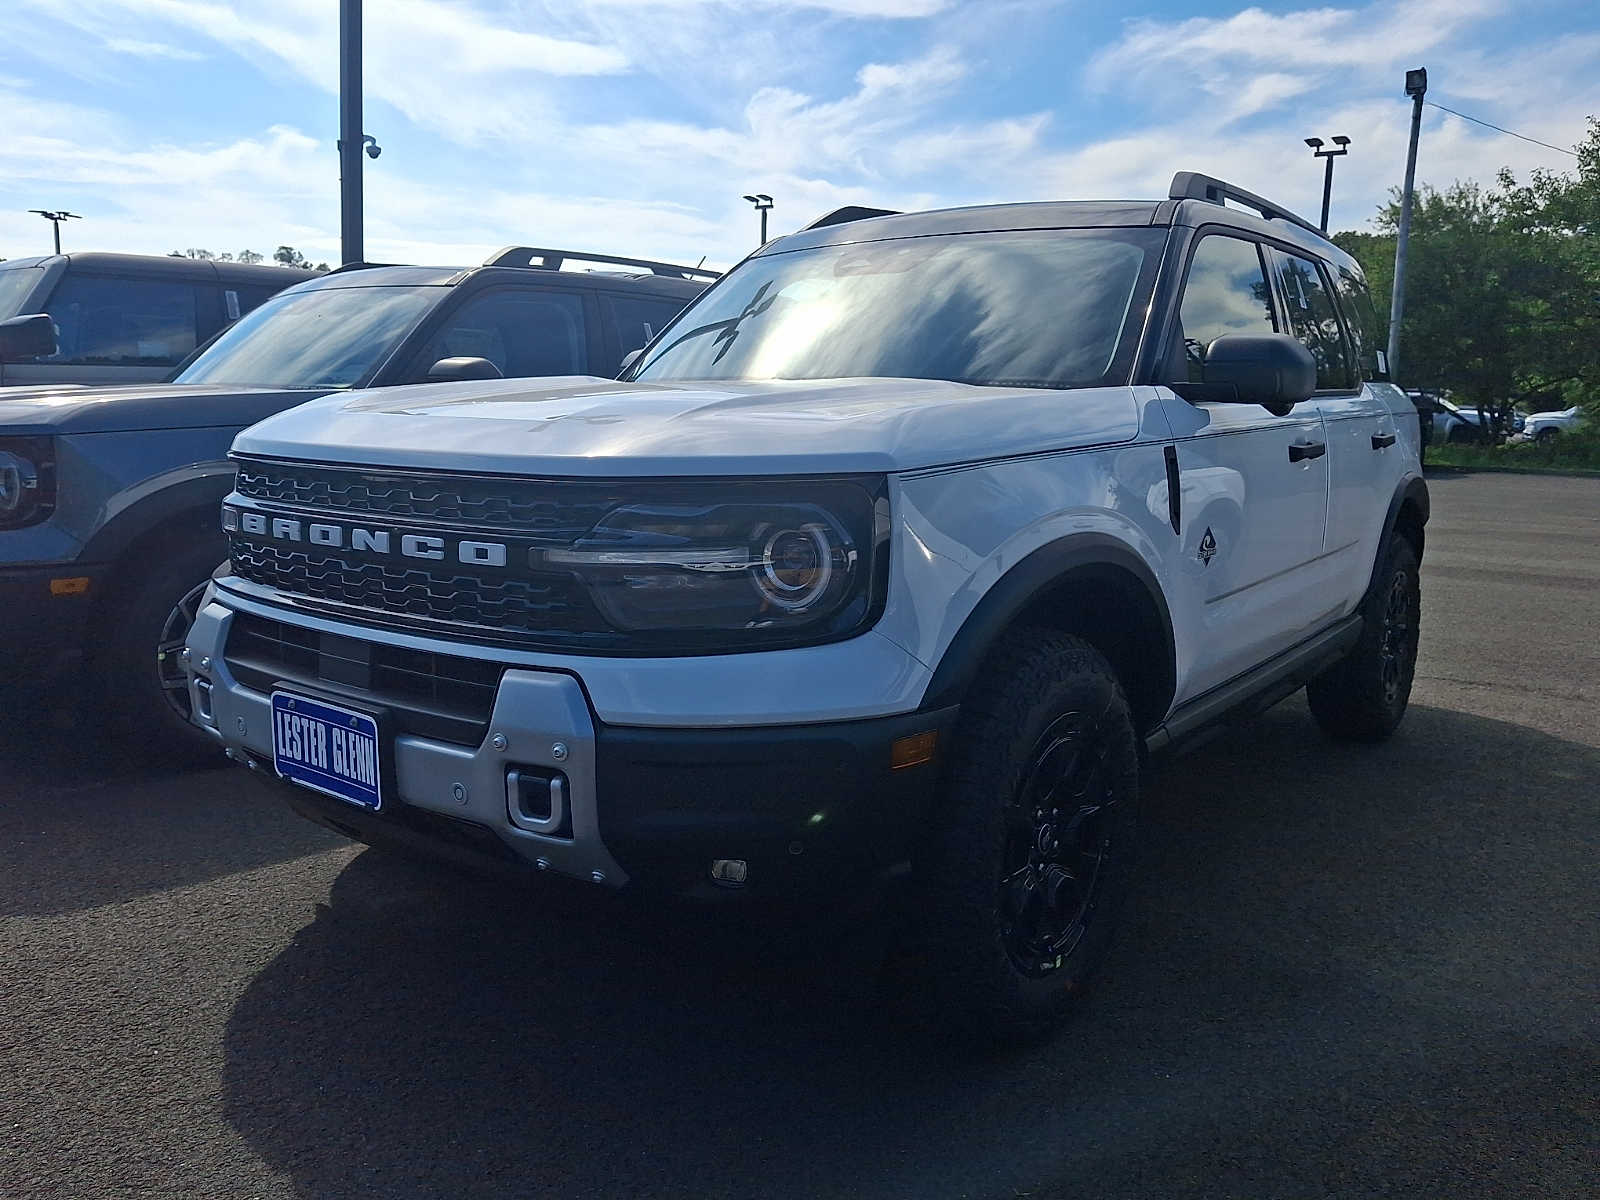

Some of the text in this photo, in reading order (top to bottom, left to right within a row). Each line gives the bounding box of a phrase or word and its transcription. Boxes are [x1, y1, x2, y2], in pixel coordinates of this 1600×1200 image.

[242, 512, 507, 567] BRONCO
[276, 711, 376, 787] LESTER GLENN
